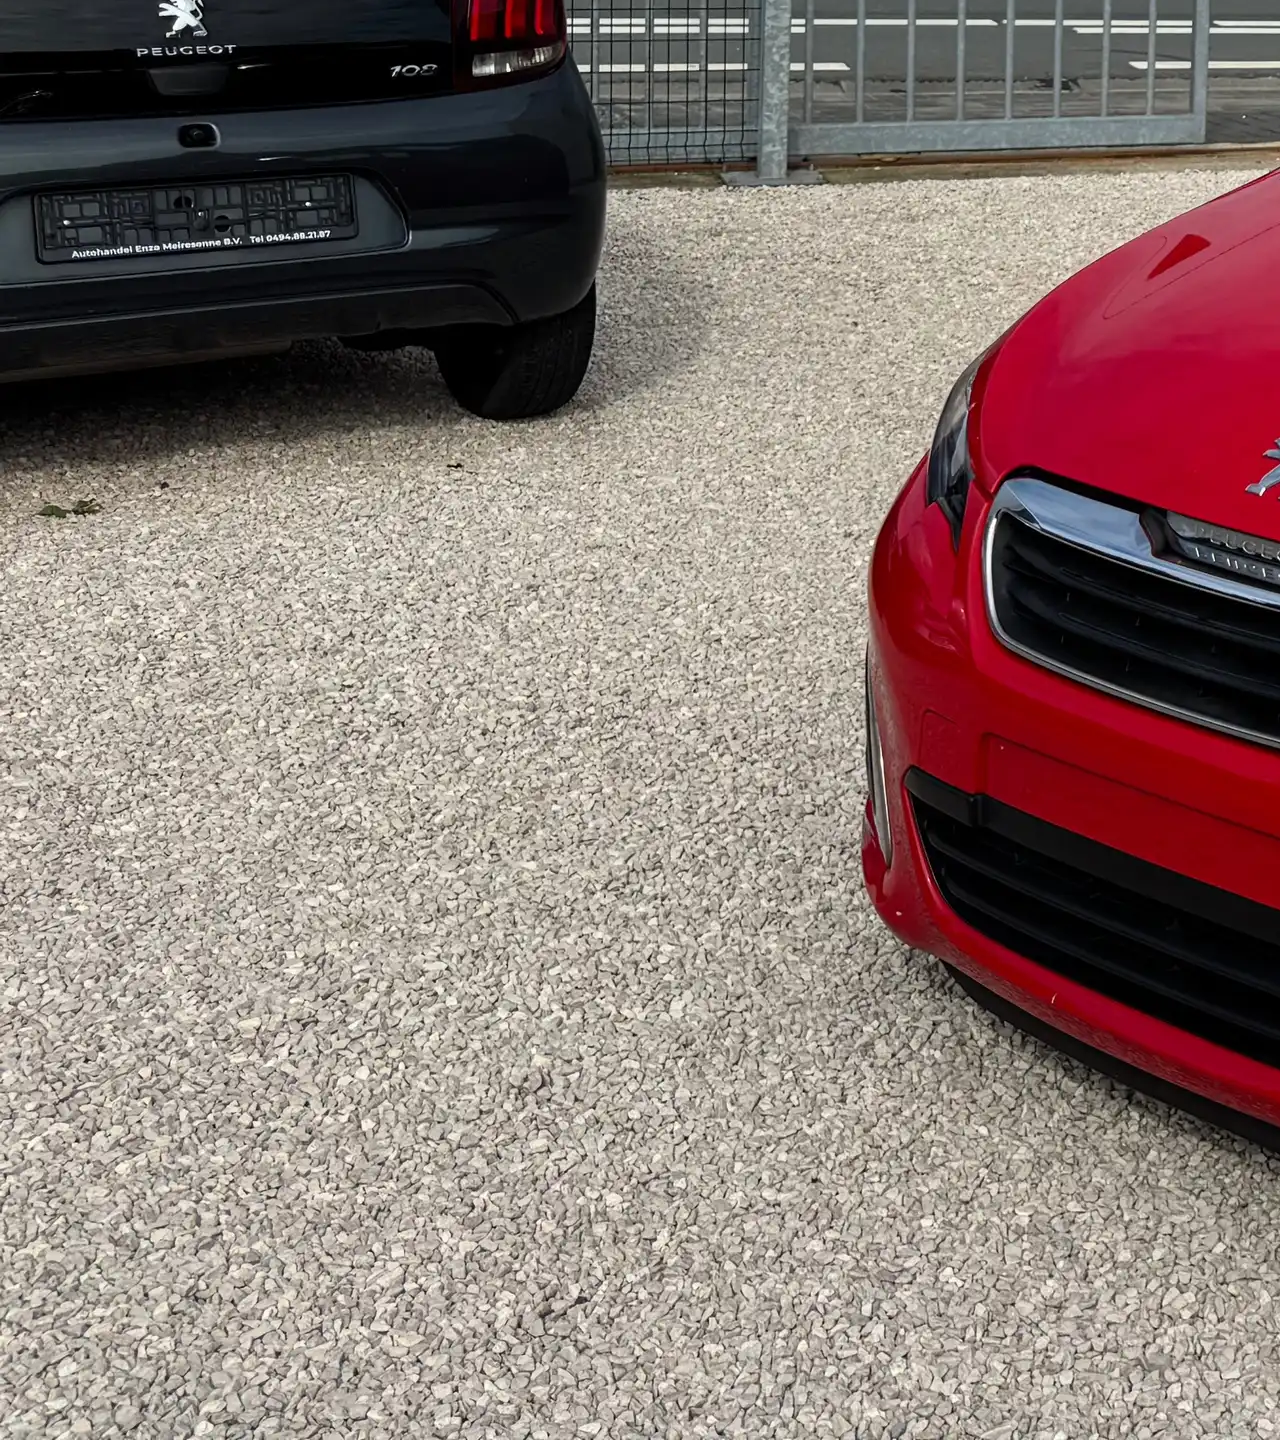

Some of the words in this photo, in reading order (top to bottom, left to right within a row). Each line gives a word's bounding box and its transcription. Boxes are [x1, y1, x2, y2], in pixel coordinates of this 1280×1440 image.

[137, 44, 237, 57] PEUGEOT
[390, 63, 439, 78] 108
[72, 246, 133, 258] Autohandel
[135, 244, 160, 253] Enzo
[162, 240, 221, 251] Meiresonne
